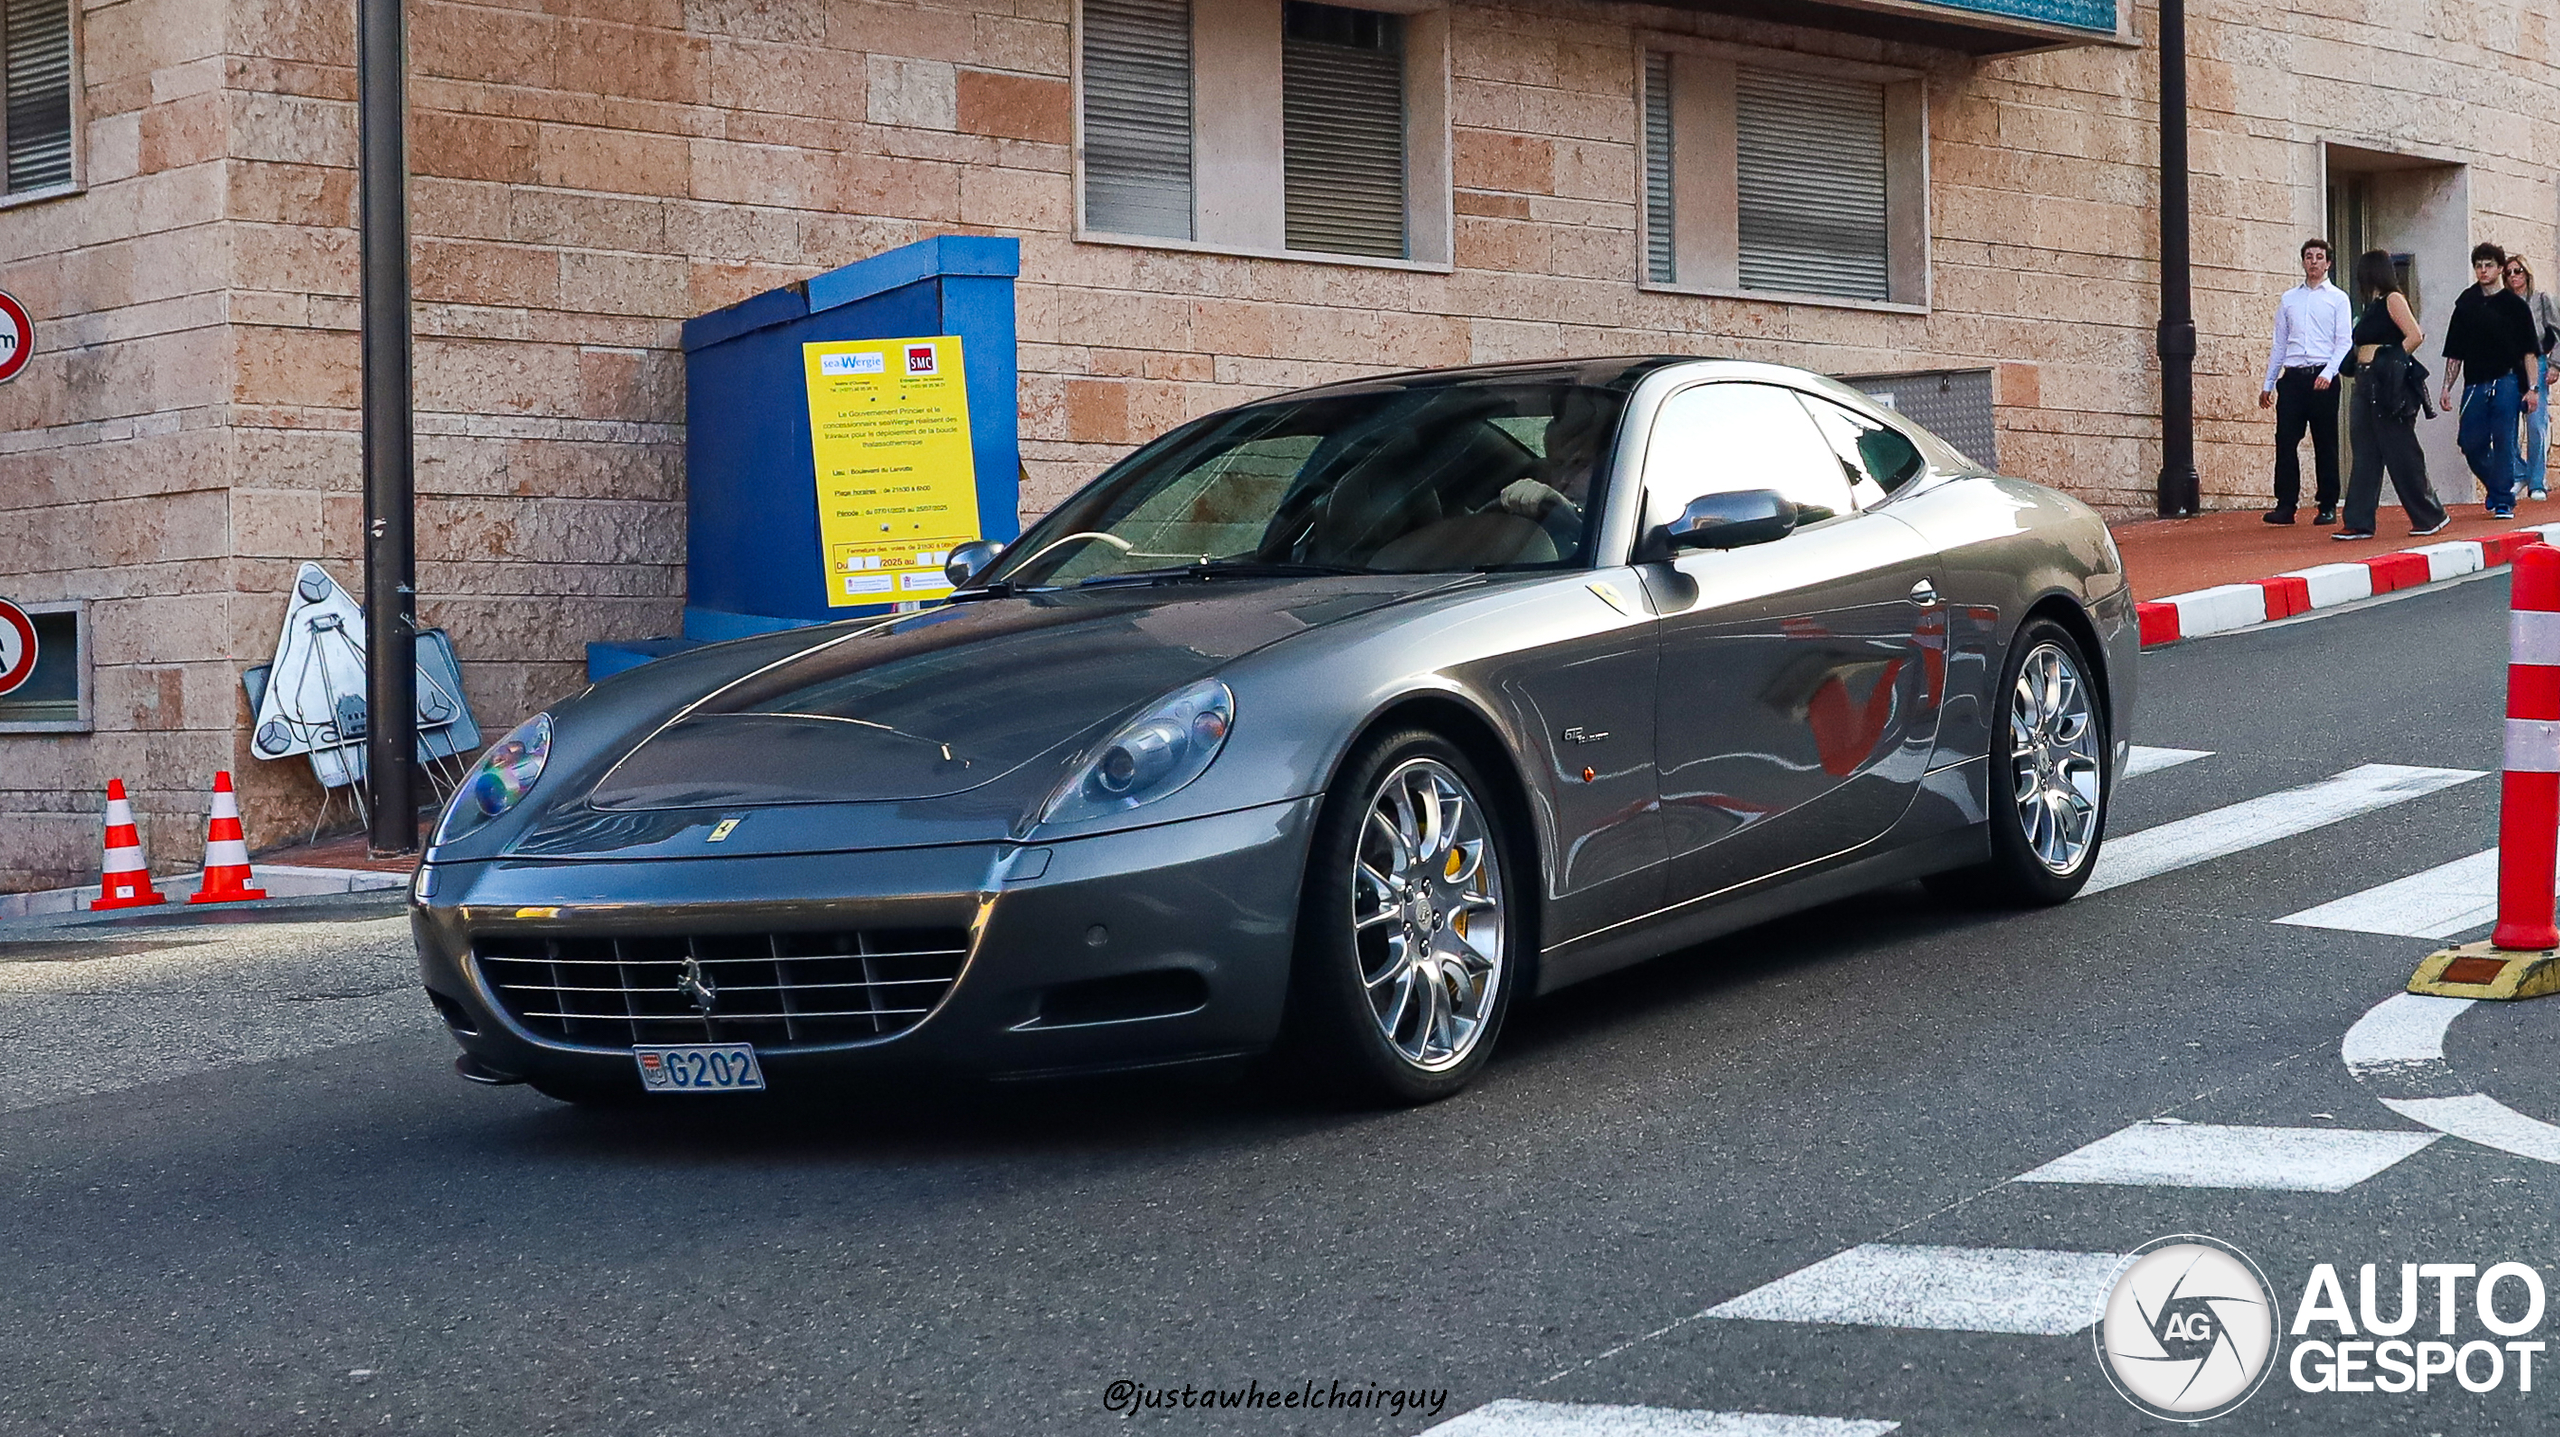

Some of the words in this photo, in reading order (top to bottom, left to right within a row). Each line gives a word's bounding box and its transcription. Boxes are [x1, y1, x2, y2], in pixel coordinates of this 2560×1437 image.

[910, 356, 933, 370] SMC
[848, 409, 898, 417] Gouvernement
[822, 421, 877, 429] concessionnaire
[916, 416, 944, 424] réalisent
[876, 428, 916, 437] déploiement
[850, 467, 880, 475] Boulevard
[852, 488, 876, 496] horaires
[836, 561, 848, 570] Du
[666, 1050, 758, 1087] G202
